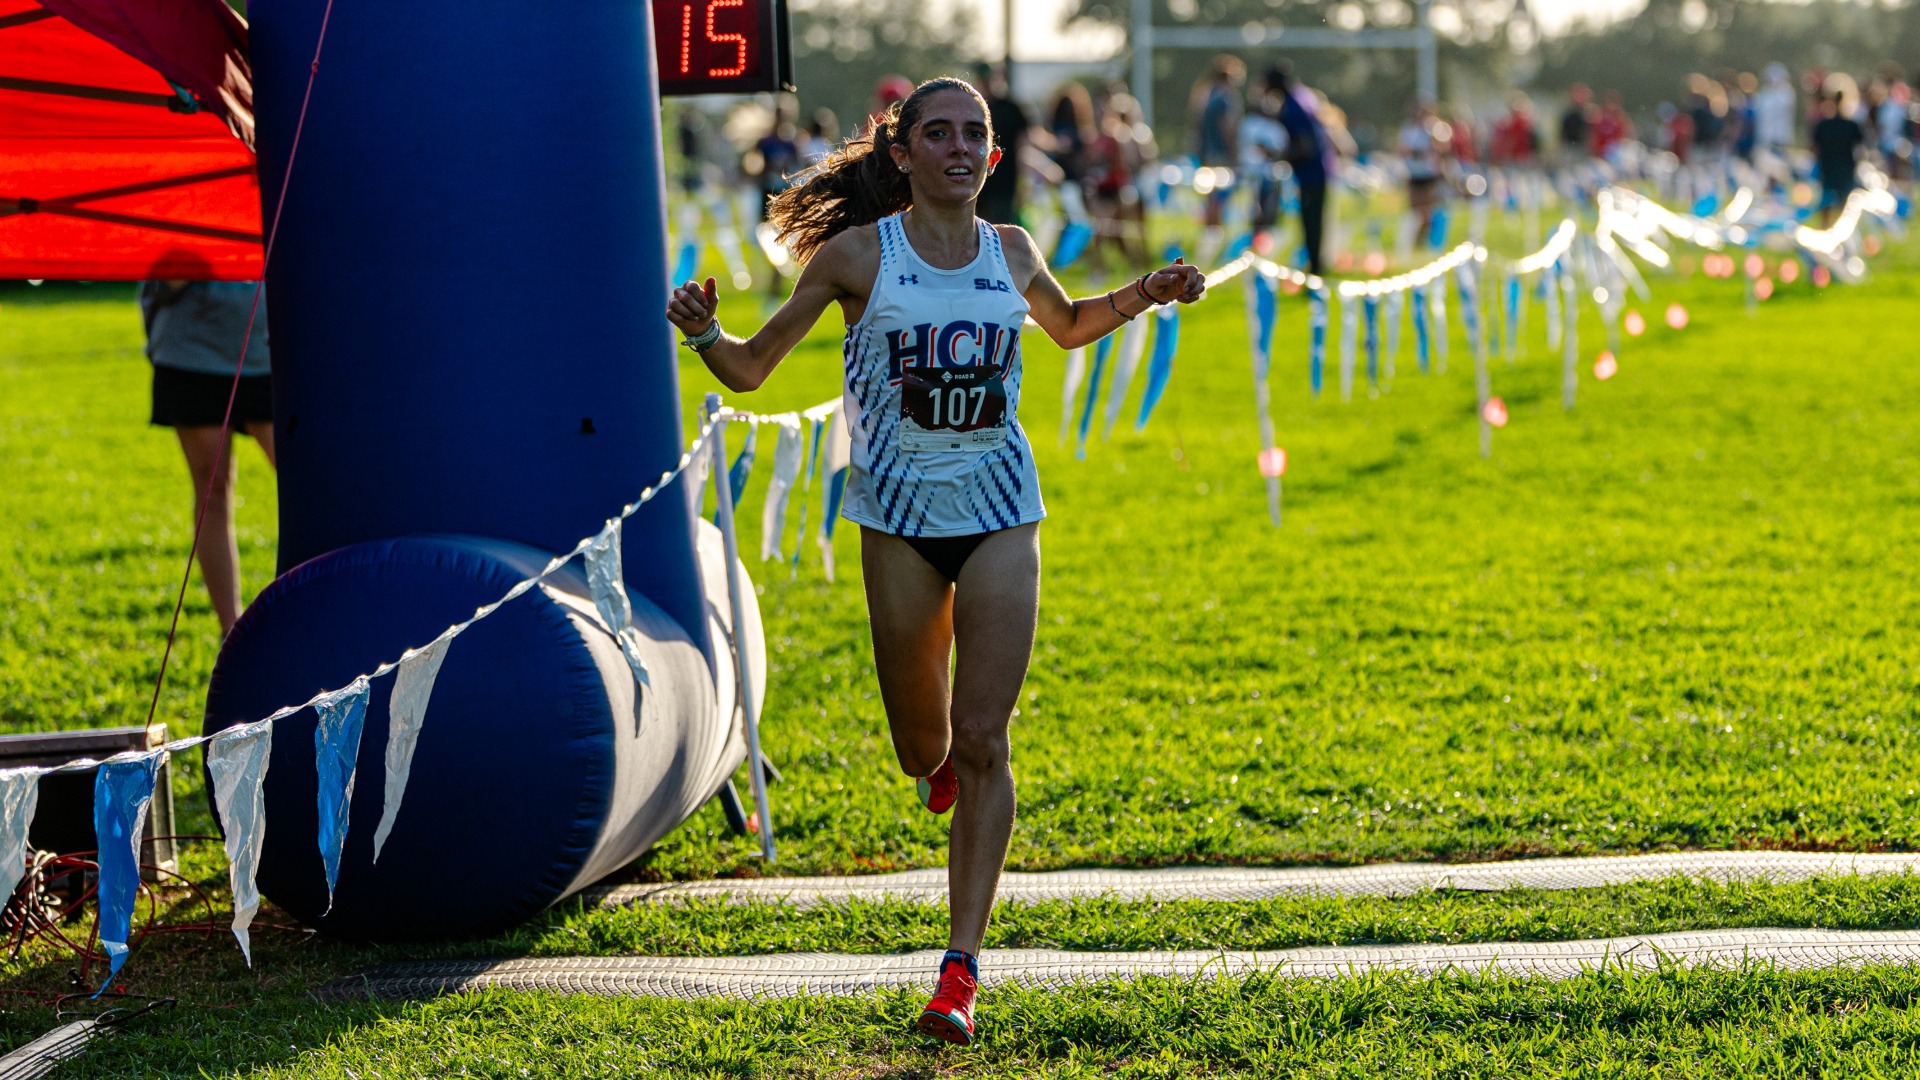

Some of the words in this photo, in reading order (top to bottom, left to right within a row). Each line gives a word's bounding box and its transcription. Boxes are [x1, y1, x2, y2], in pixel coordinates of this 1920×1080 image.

[680, 0, 746, 77] 15
[885, 320, 1019, 386] HCU
[928, 386, 987, 426] 107
